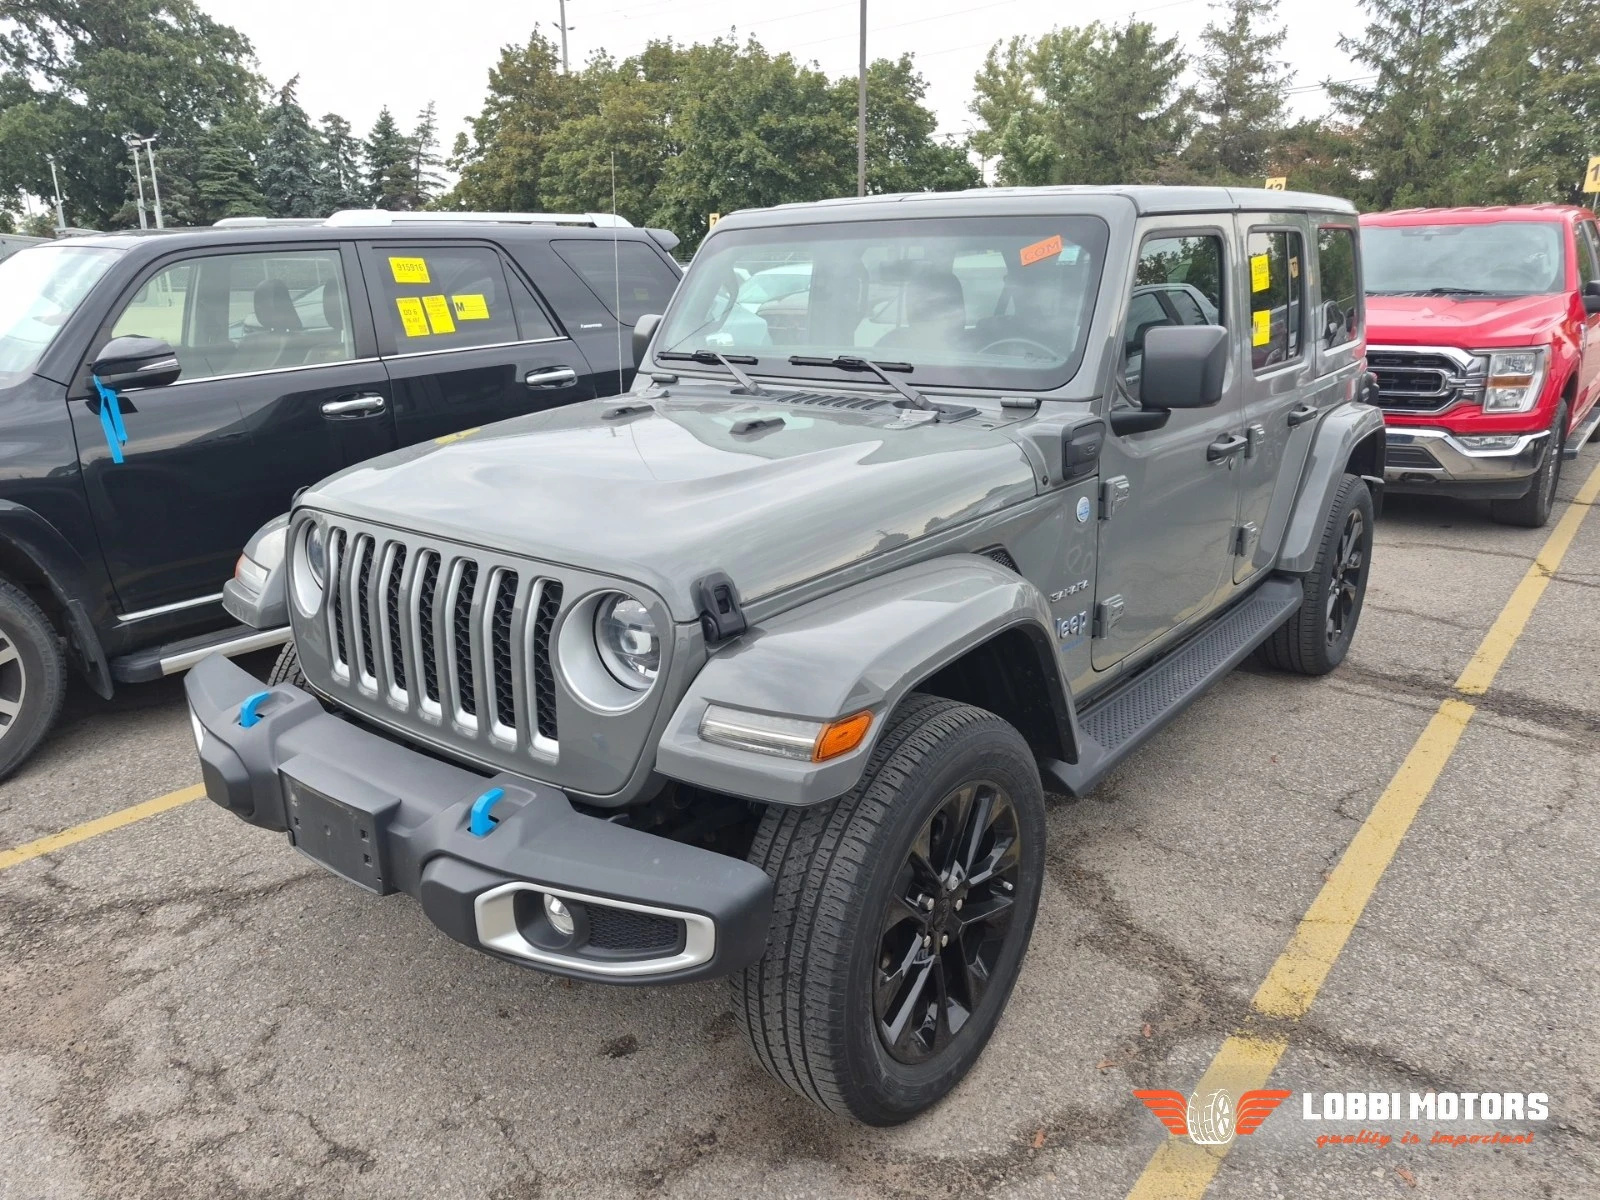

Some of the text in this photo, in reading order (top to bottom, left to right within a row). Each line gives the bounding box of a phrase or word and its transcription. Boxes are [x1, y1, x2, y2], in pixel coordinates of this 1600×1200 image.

[711, 217, 717, 225] 7
[455, 302, 464, 312] M
[1055, 610, 1087, 638] Jeep
